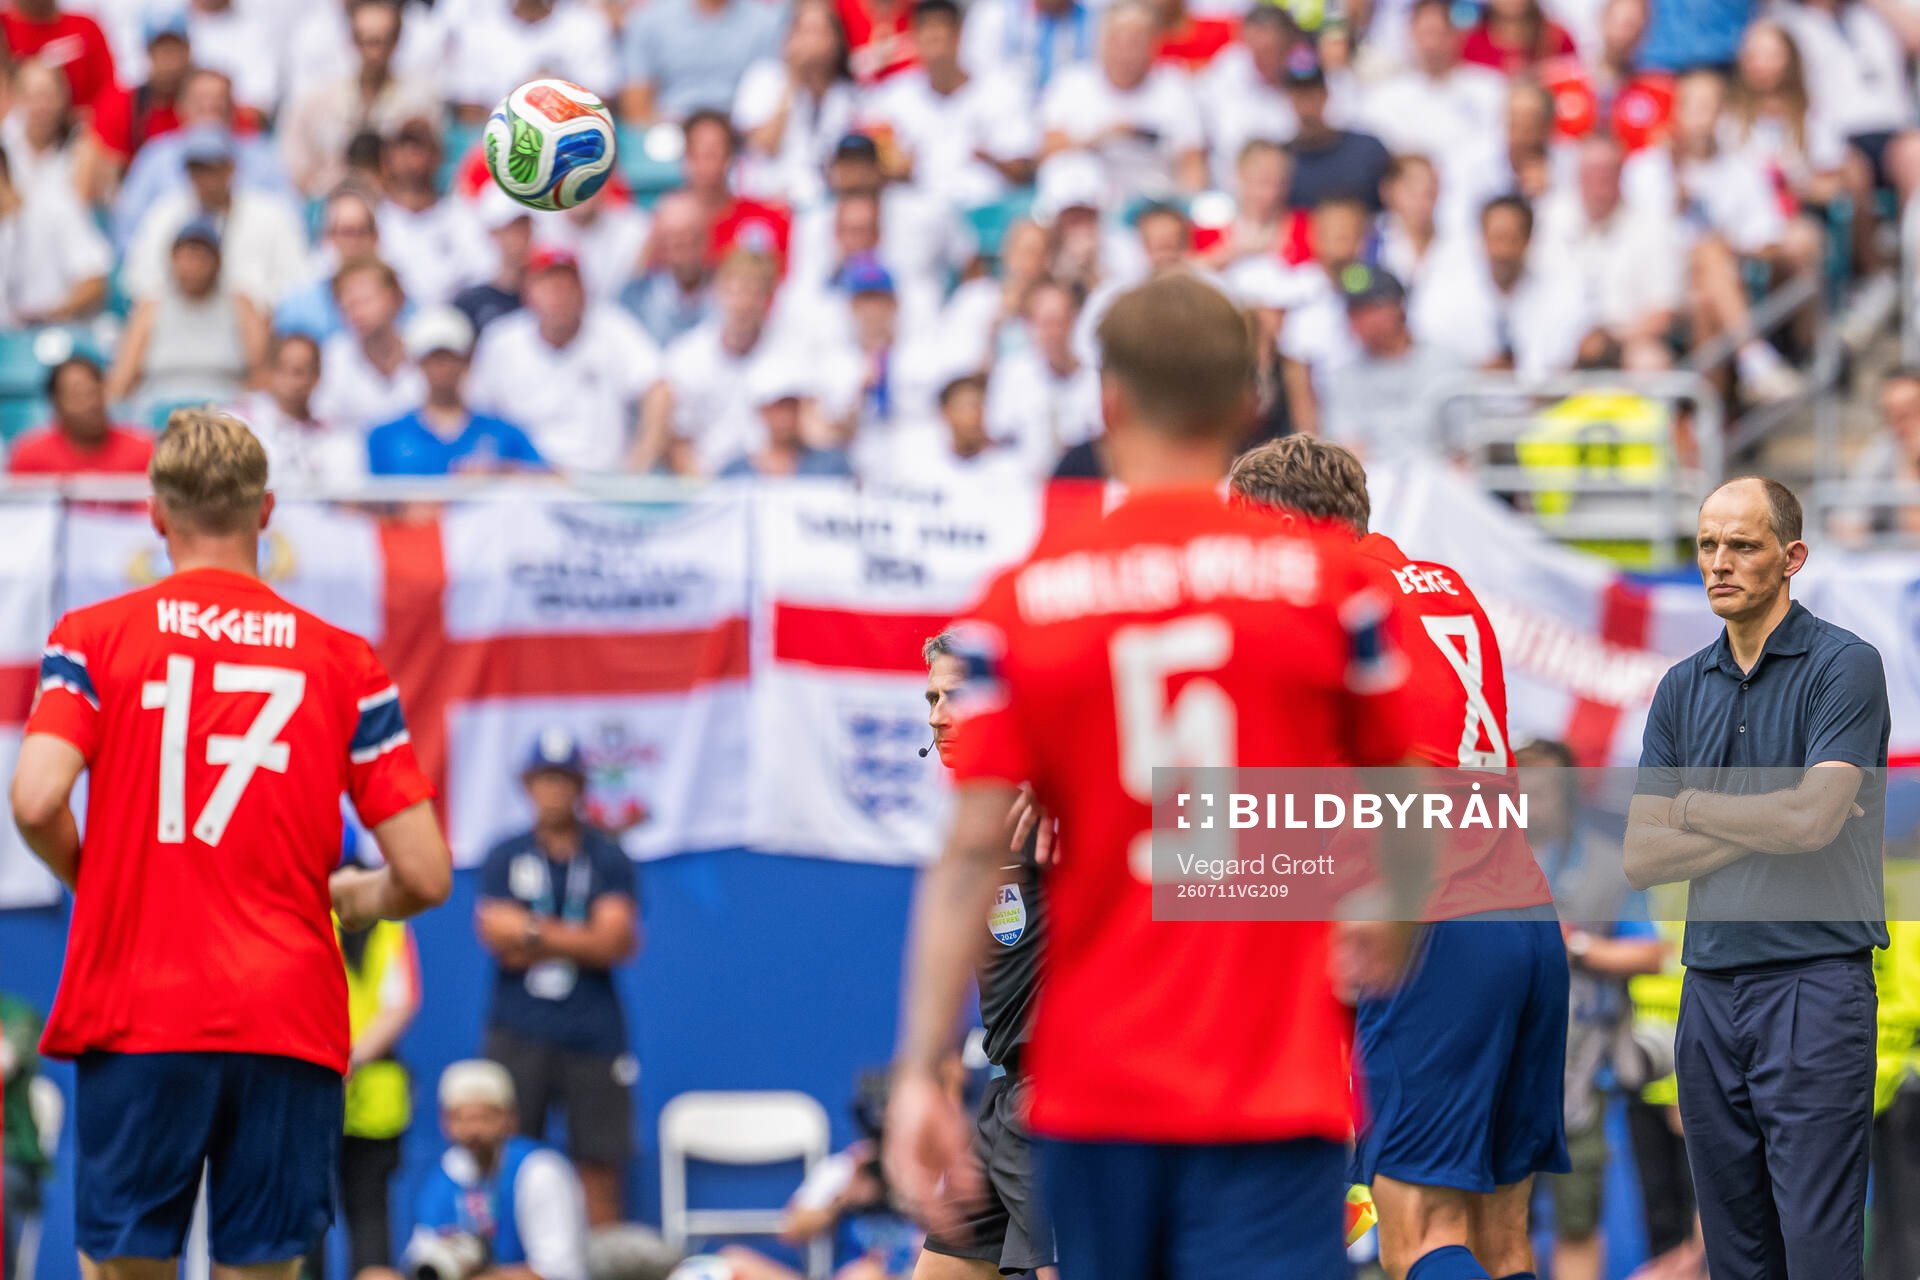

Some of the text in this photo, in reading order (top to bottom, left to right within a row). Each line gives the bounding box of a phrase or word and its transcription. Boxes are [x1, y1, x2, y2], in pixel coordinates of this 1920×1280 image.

[157, 598, 296, 648] HEGGEM
[1420, 614, 1507, 775] 8
[141, 654, 306, 847] 17
[1110, 614, 1238, 884] 5
[1001, 931, 1018, 942] 2026
